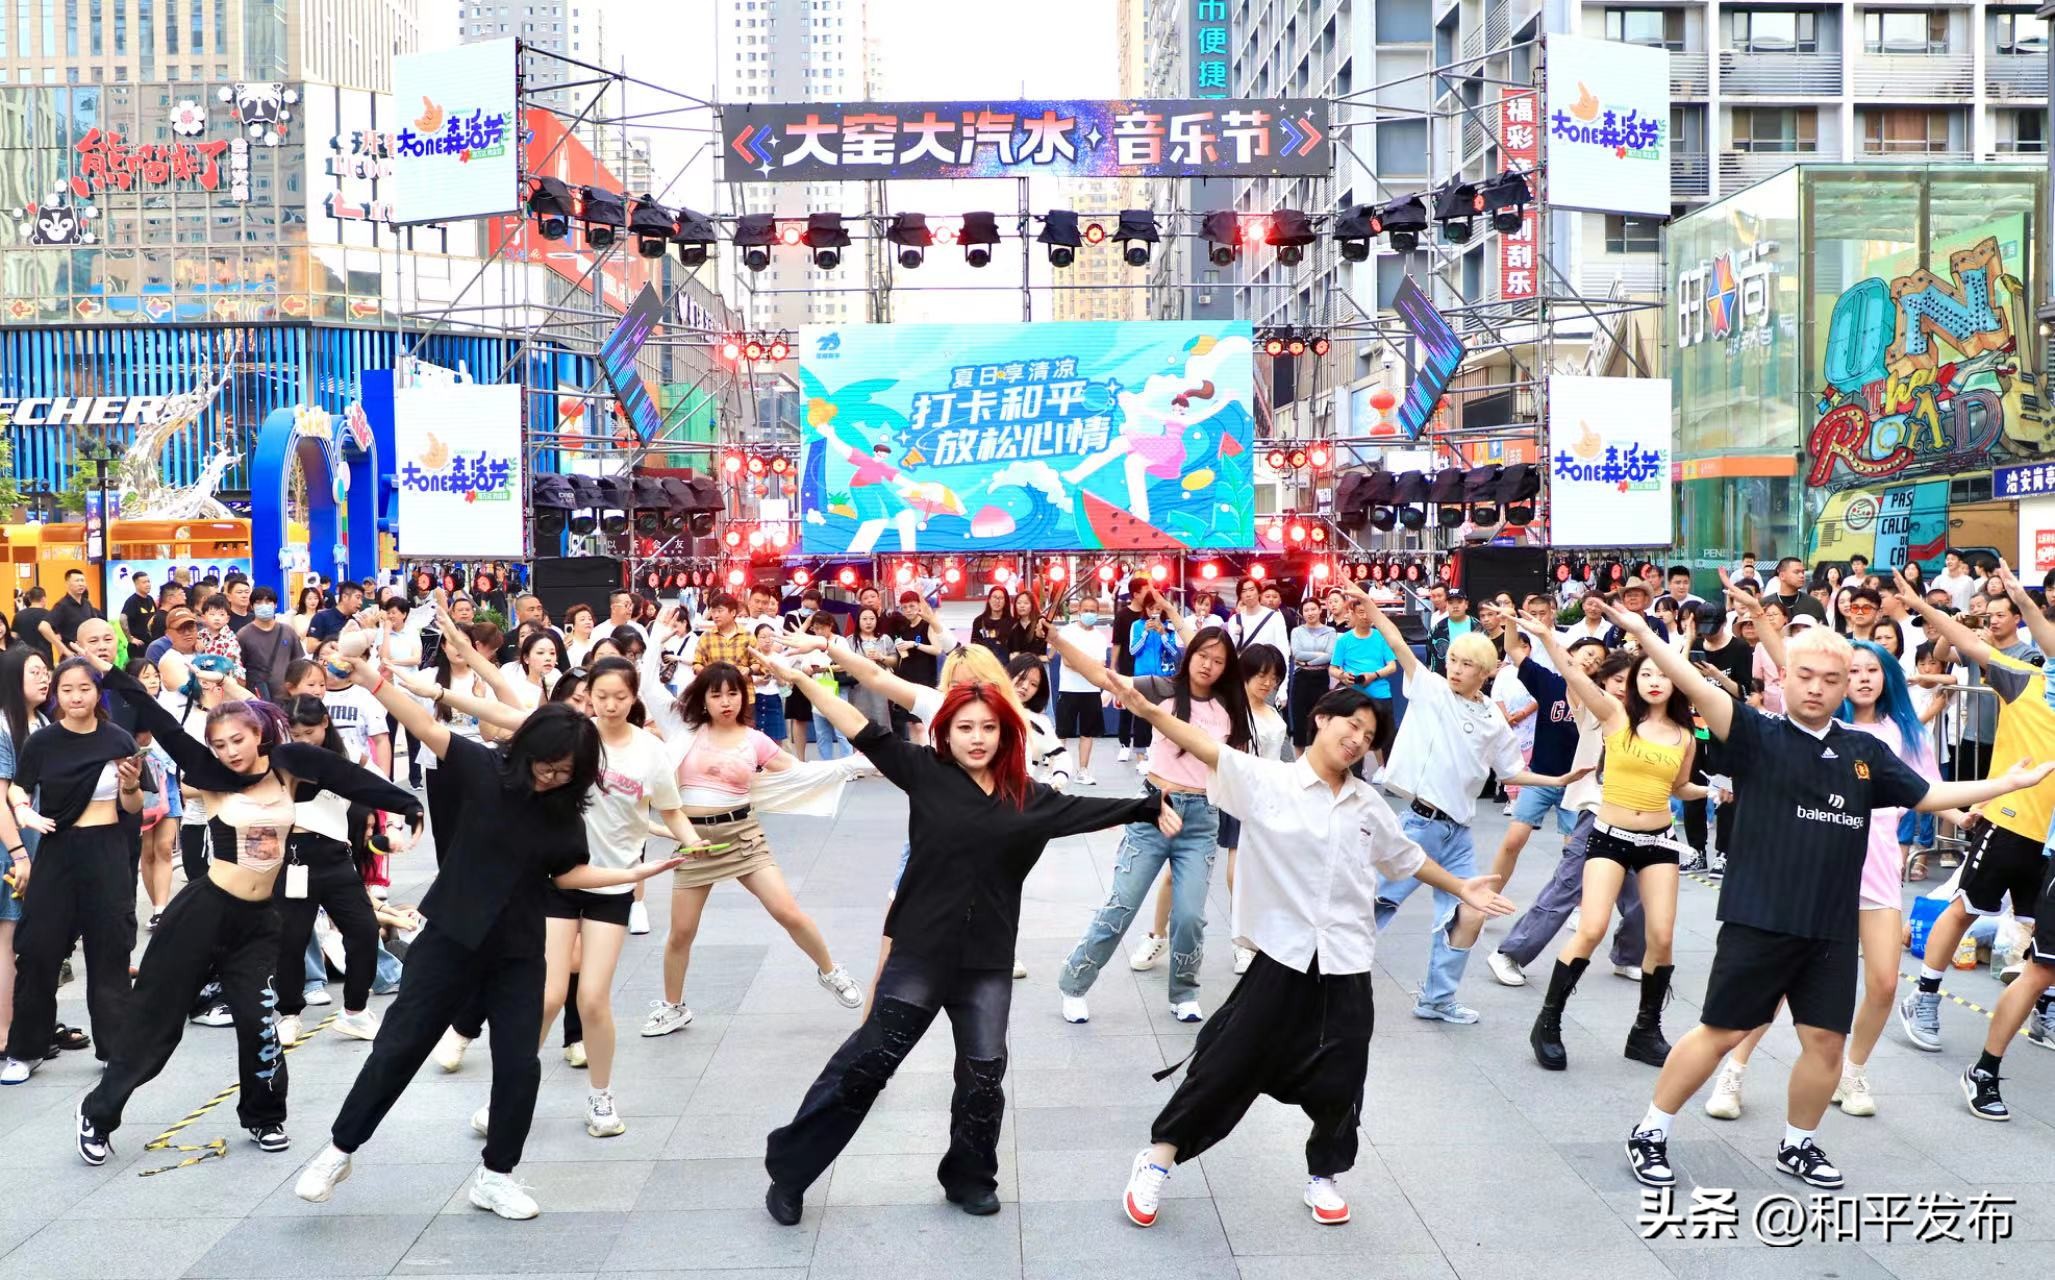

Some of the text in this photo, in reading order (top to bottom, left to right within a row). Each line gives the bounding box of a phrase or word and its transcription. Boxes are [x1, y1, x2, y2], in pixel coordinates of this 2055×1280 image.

[1198, 0, 1227, 99] 市便捷
[782, 110, 1272, 166] 大窑大汽水 音乐节
[1824, 236, 2009, 392] ON
[952, 358, 1078, 388] 夏日享清凉
[0, 396, 172, 425] CHER
[911, 380, 1089, 431] 打卡和平
[933, 416, 1112, 466] 放松心情
[1806, 384, 2004, 487] ROAD
